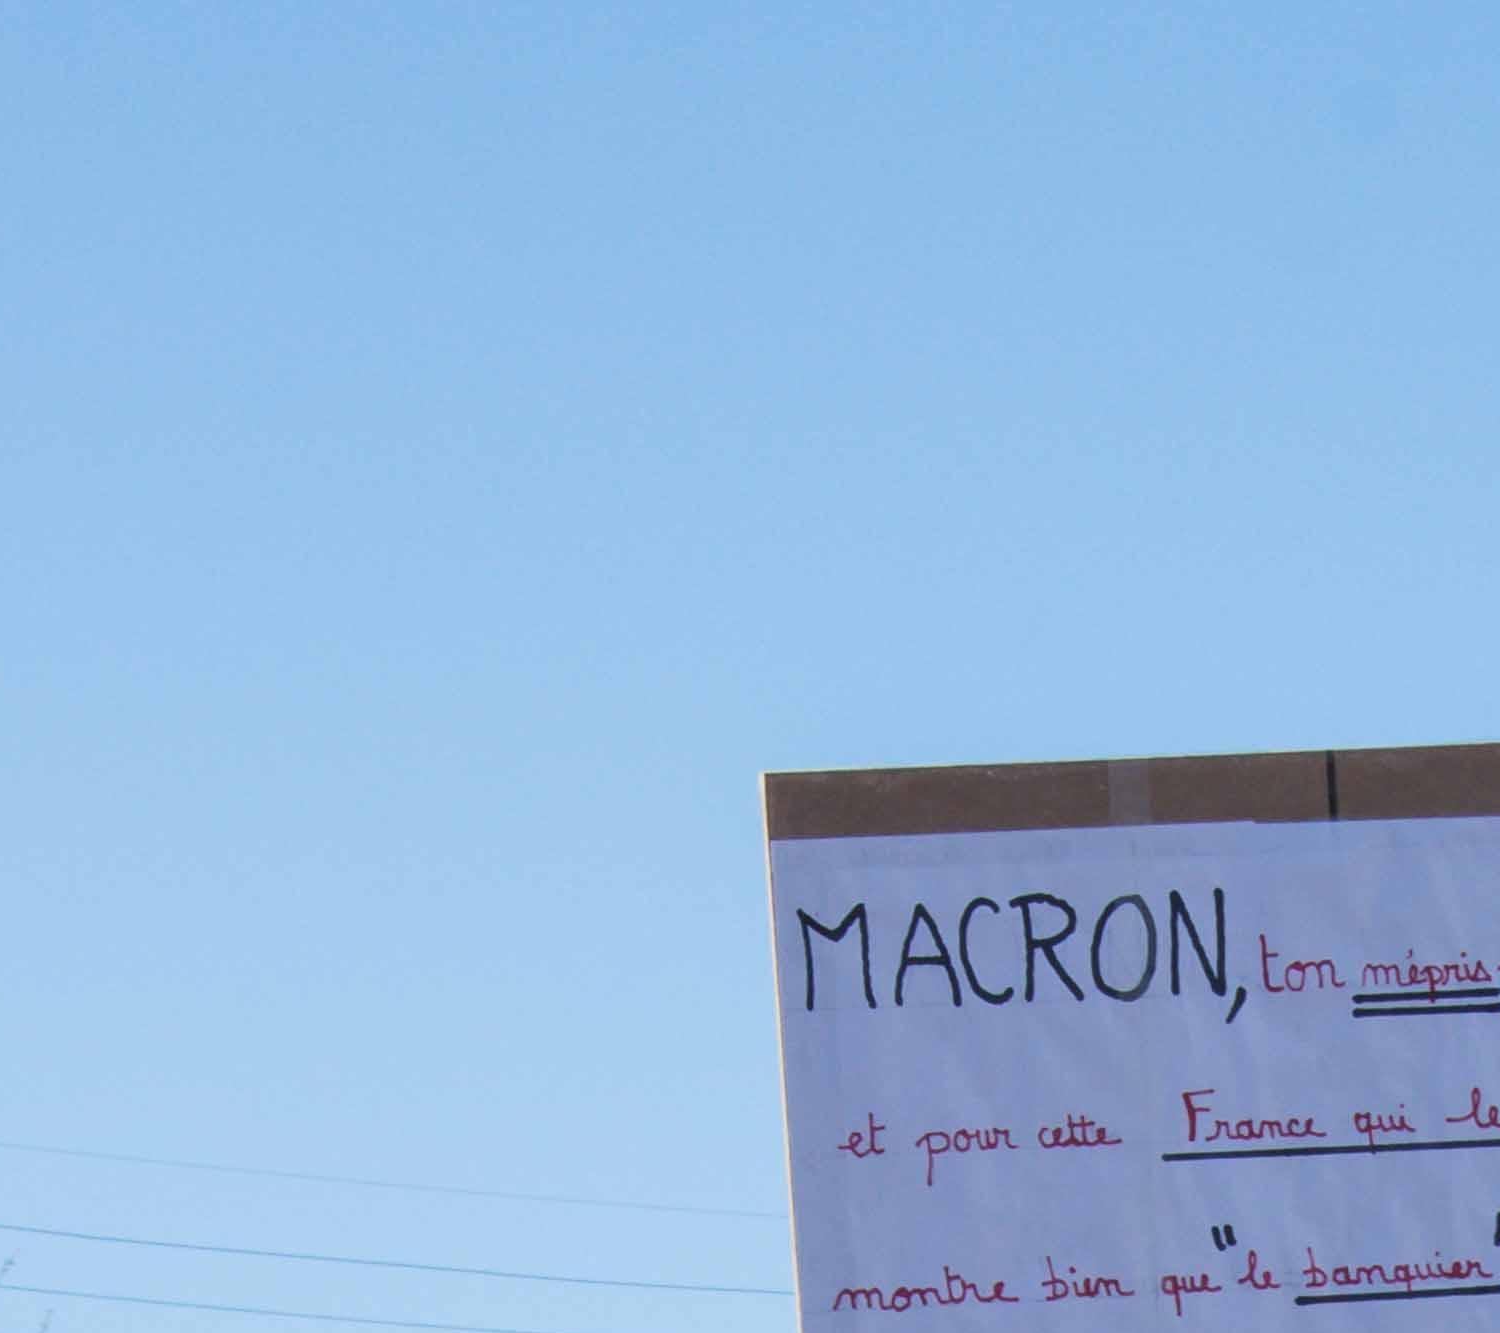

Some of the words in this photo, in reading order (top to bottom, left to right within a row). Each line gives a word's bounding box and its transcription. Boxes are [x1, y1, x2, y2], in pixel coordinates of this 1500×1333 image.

[797, 887, 1247, 1024] MACRON,
[1258, 933, 1346, 994] ton
[1361, 946, 1494, 1004] mépris
[837, 1112, 886, 1158] et
[915, 1126, 1018, 1187] pour
[1037, 1113, 1124, 1150] cette
[1181, 1088, 1328, 1143] France
[1354, 1103, 1416, 1155] qui
[832, 1265, 1021, 1312] montre
[1040, 1255, 1136, 1302] bien
[1161, 1271, 1223, 1317] que
